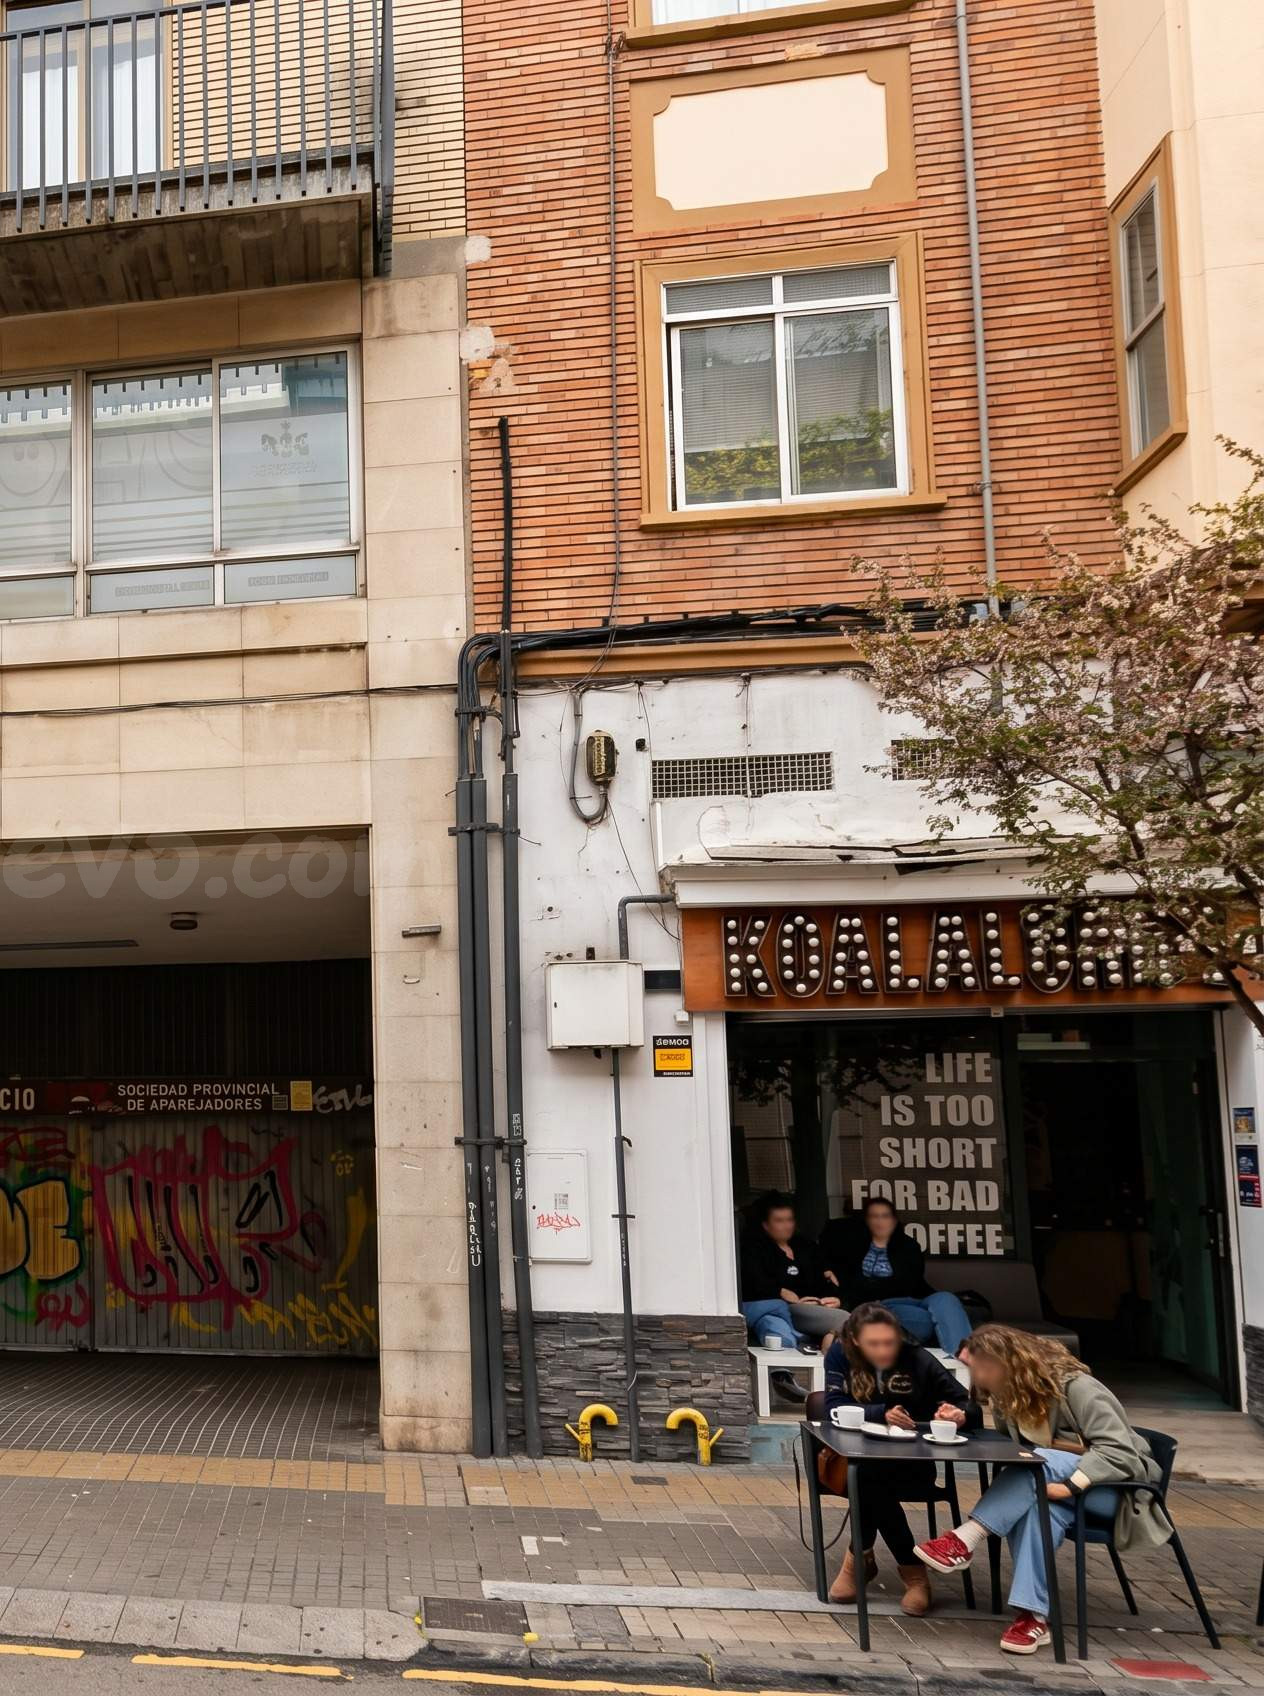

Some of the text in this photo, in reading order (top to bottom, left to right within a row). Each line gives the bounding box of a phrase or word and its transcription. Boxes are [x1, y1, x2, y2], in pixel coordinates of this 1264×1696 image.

[926, 1053, 993, 1083] LIFE
[117, 1083, 280, 1096] SOCIEDAD PROVINCIAL
[127, 1099, 262, 1111] DE APAREJADORES
[881, 1095, 994, 1126] IS TOO
[879, 1137, 997, 1169] SHORT
[851, 1179, 999, 1212] FOR BAD
[903, 1222, 1004, 1255] OFFEE
